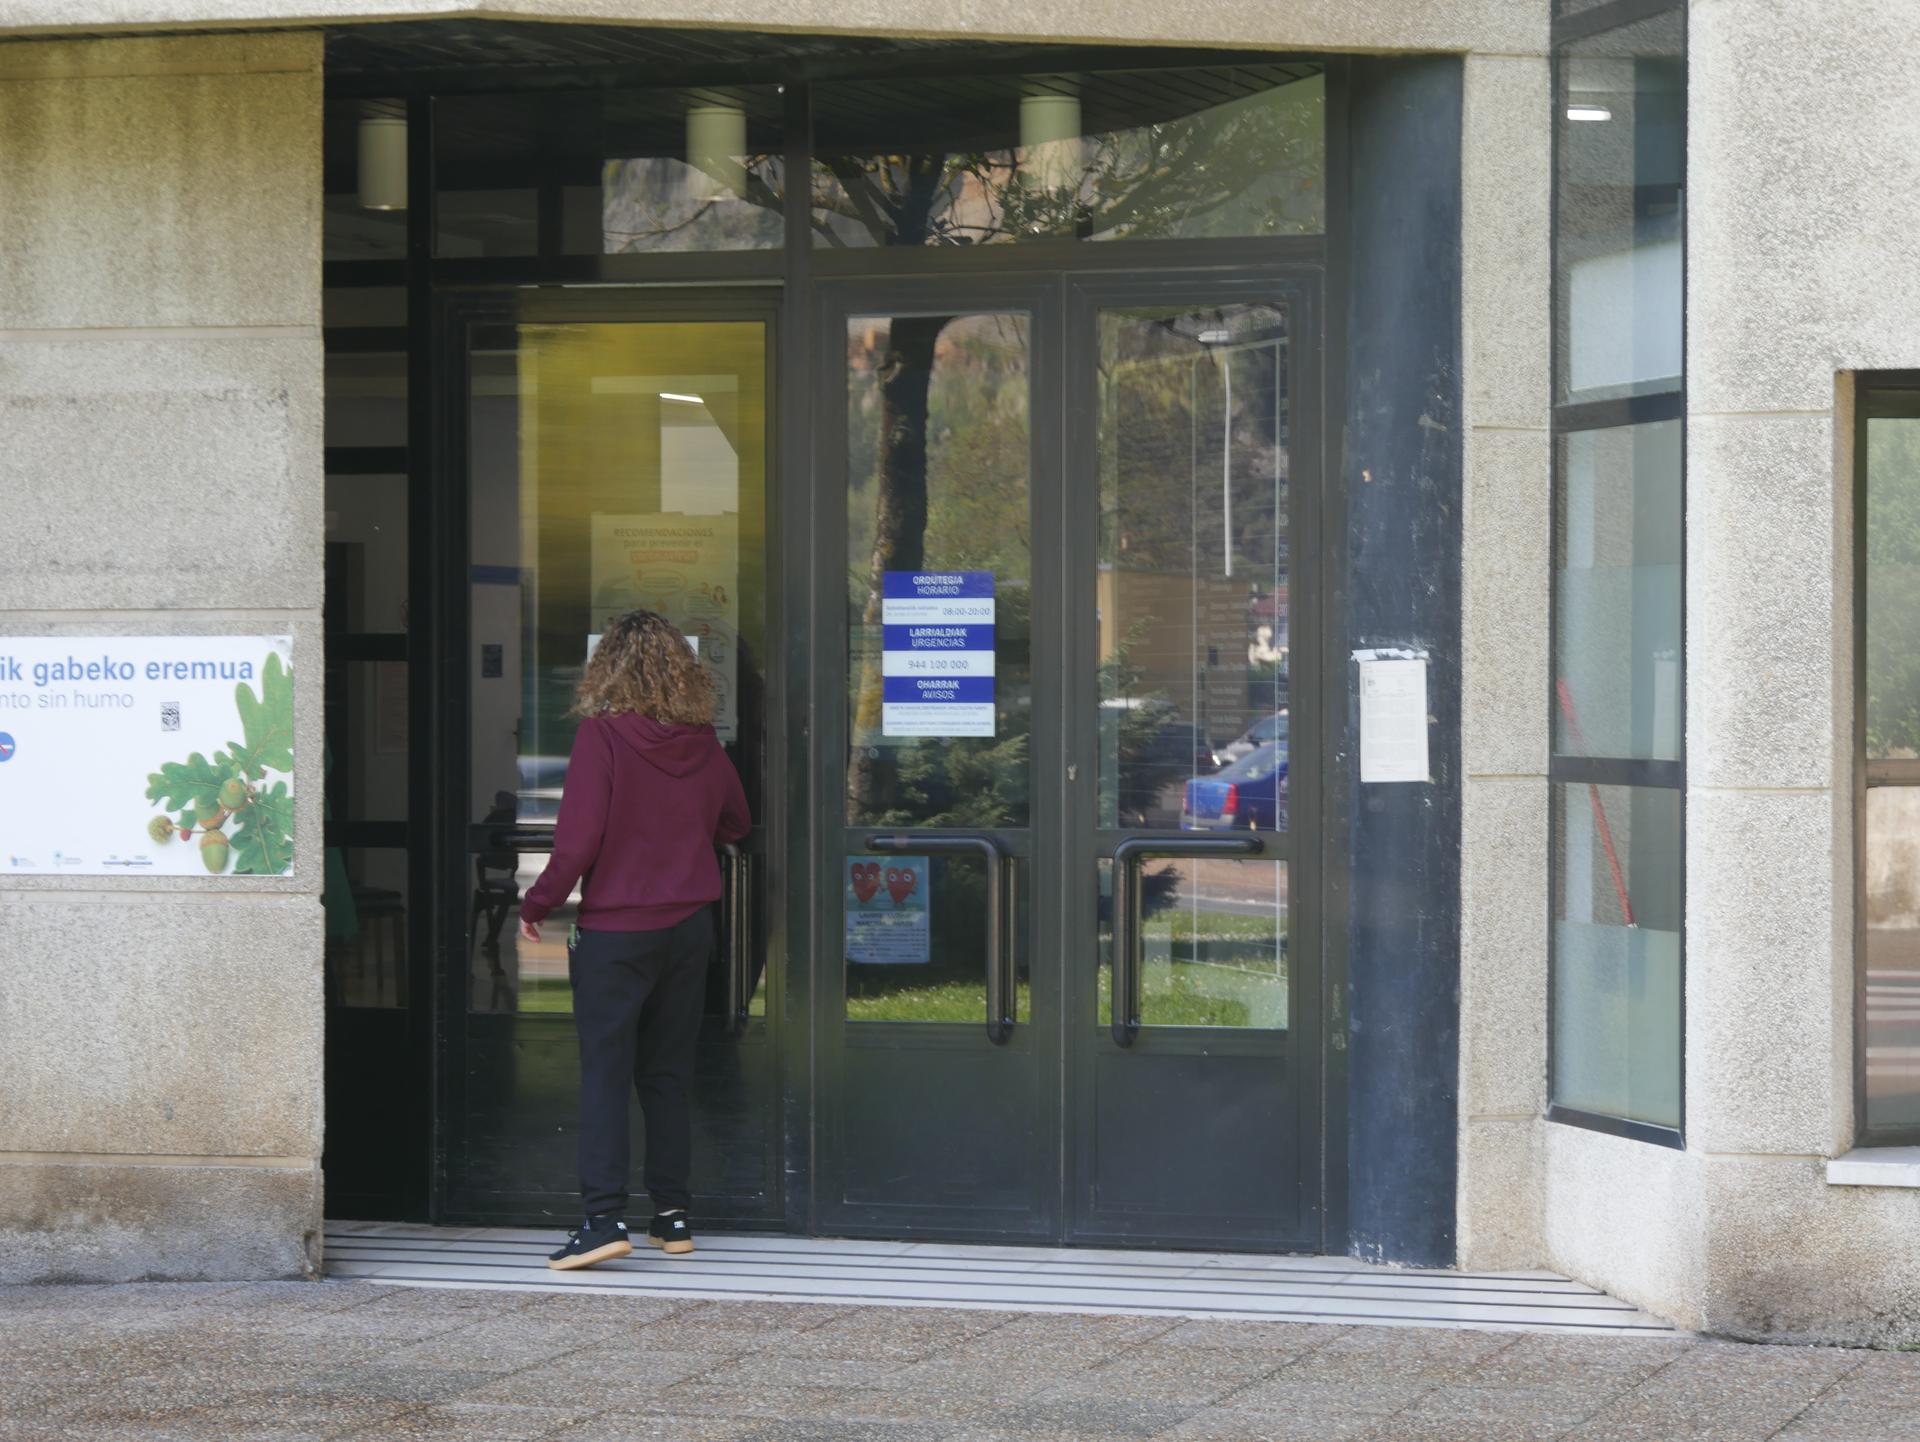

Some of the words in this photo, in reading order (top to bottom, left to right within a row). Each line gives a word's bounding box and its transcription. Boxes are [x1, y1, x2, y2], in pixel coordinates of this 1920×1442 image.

[614, 527, 713, 537] RECOMENDACIONES
[913, 576, 964, 585] ORDUTEGIA
[917, 586, 960, 595] HORARIO
[909, 629, 967, 637] LARRIALDIAK
[911, 639, 966, 647] URGENCIAS
[930, 661, 947, 669] 100
[950, 661, 968, 669] 000
[33, 656, 135, 687] gabeko
[145, 661, 253, 680] eremua
[917, 680, 960, 689] OHARRAK
[38, 690, 67, 708] sin
[73, 690, 135, 708] humo
[922, 691, 955, 699] AVISOS
